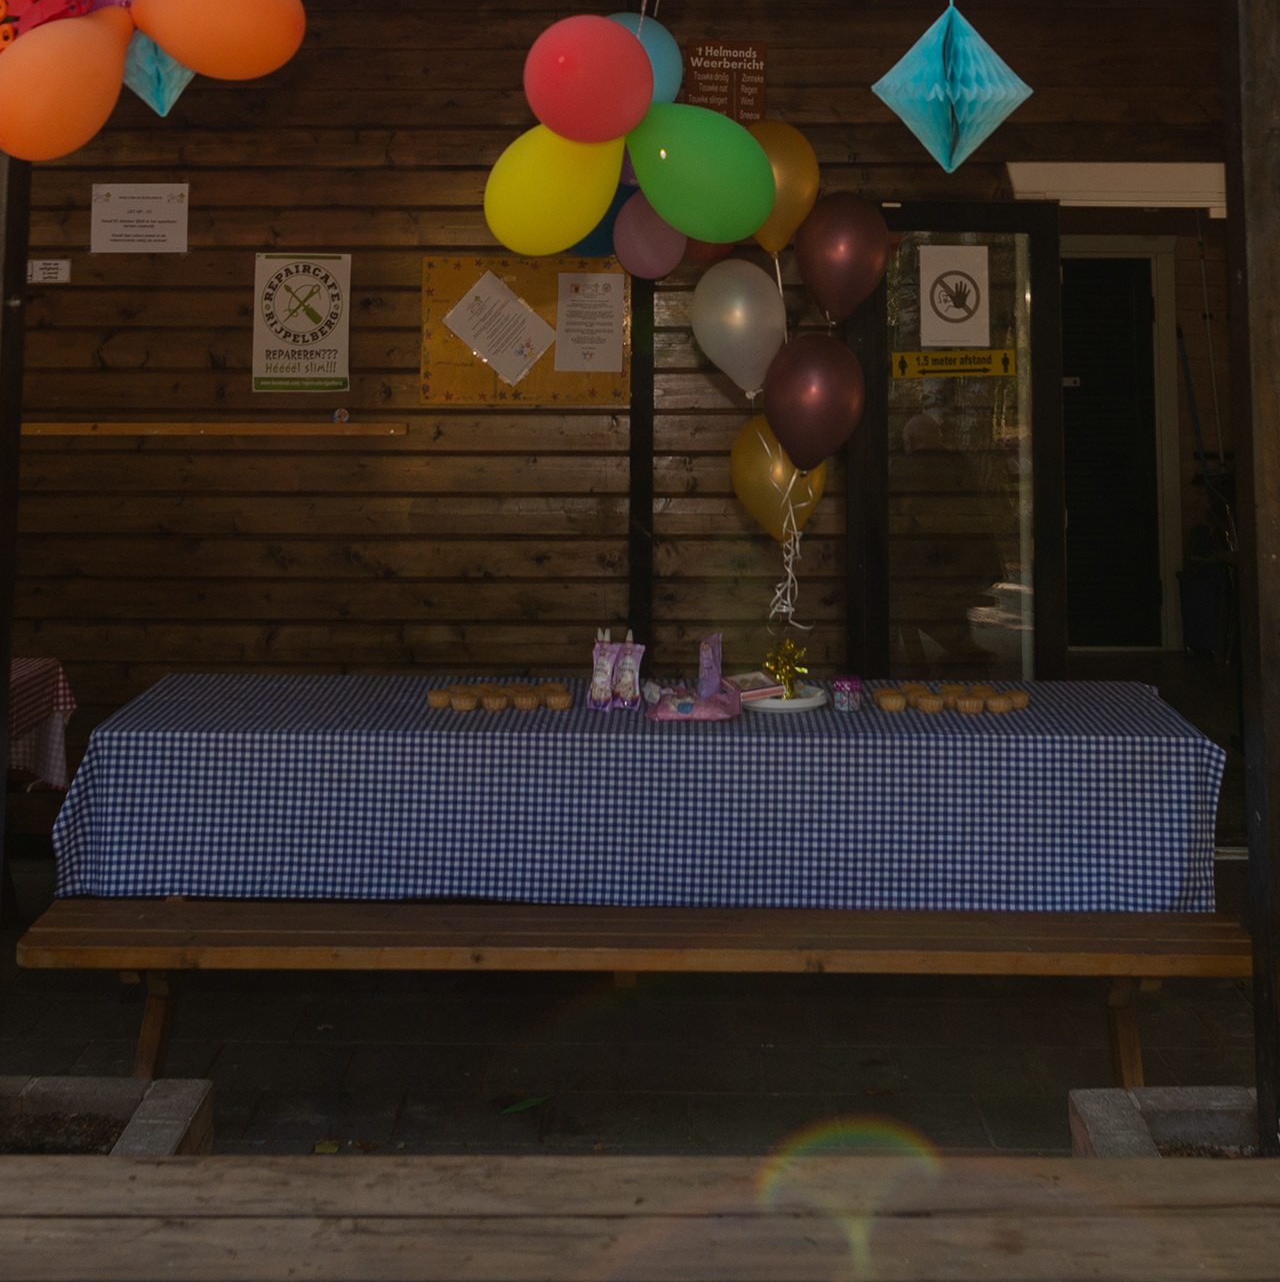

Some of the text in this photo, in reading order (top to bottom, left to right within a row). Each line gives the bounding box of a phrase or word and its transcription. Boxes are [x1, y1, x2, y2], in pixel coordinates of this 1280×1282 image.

[705, 45, 757, 58] Helmonds
[690, 57, 765, 70] Weerbericht
[740, 85, 758, 96] Regen
[740, 97, 754, 106] Wind
[264, 264, 341, 302] REPAIRCAFE
[265, 312, 339, 344] RIJPELBERG
[265, 349, 338, 360] REPAREREN???
[916, 354, 992, 367] 1.5 meter afstand
